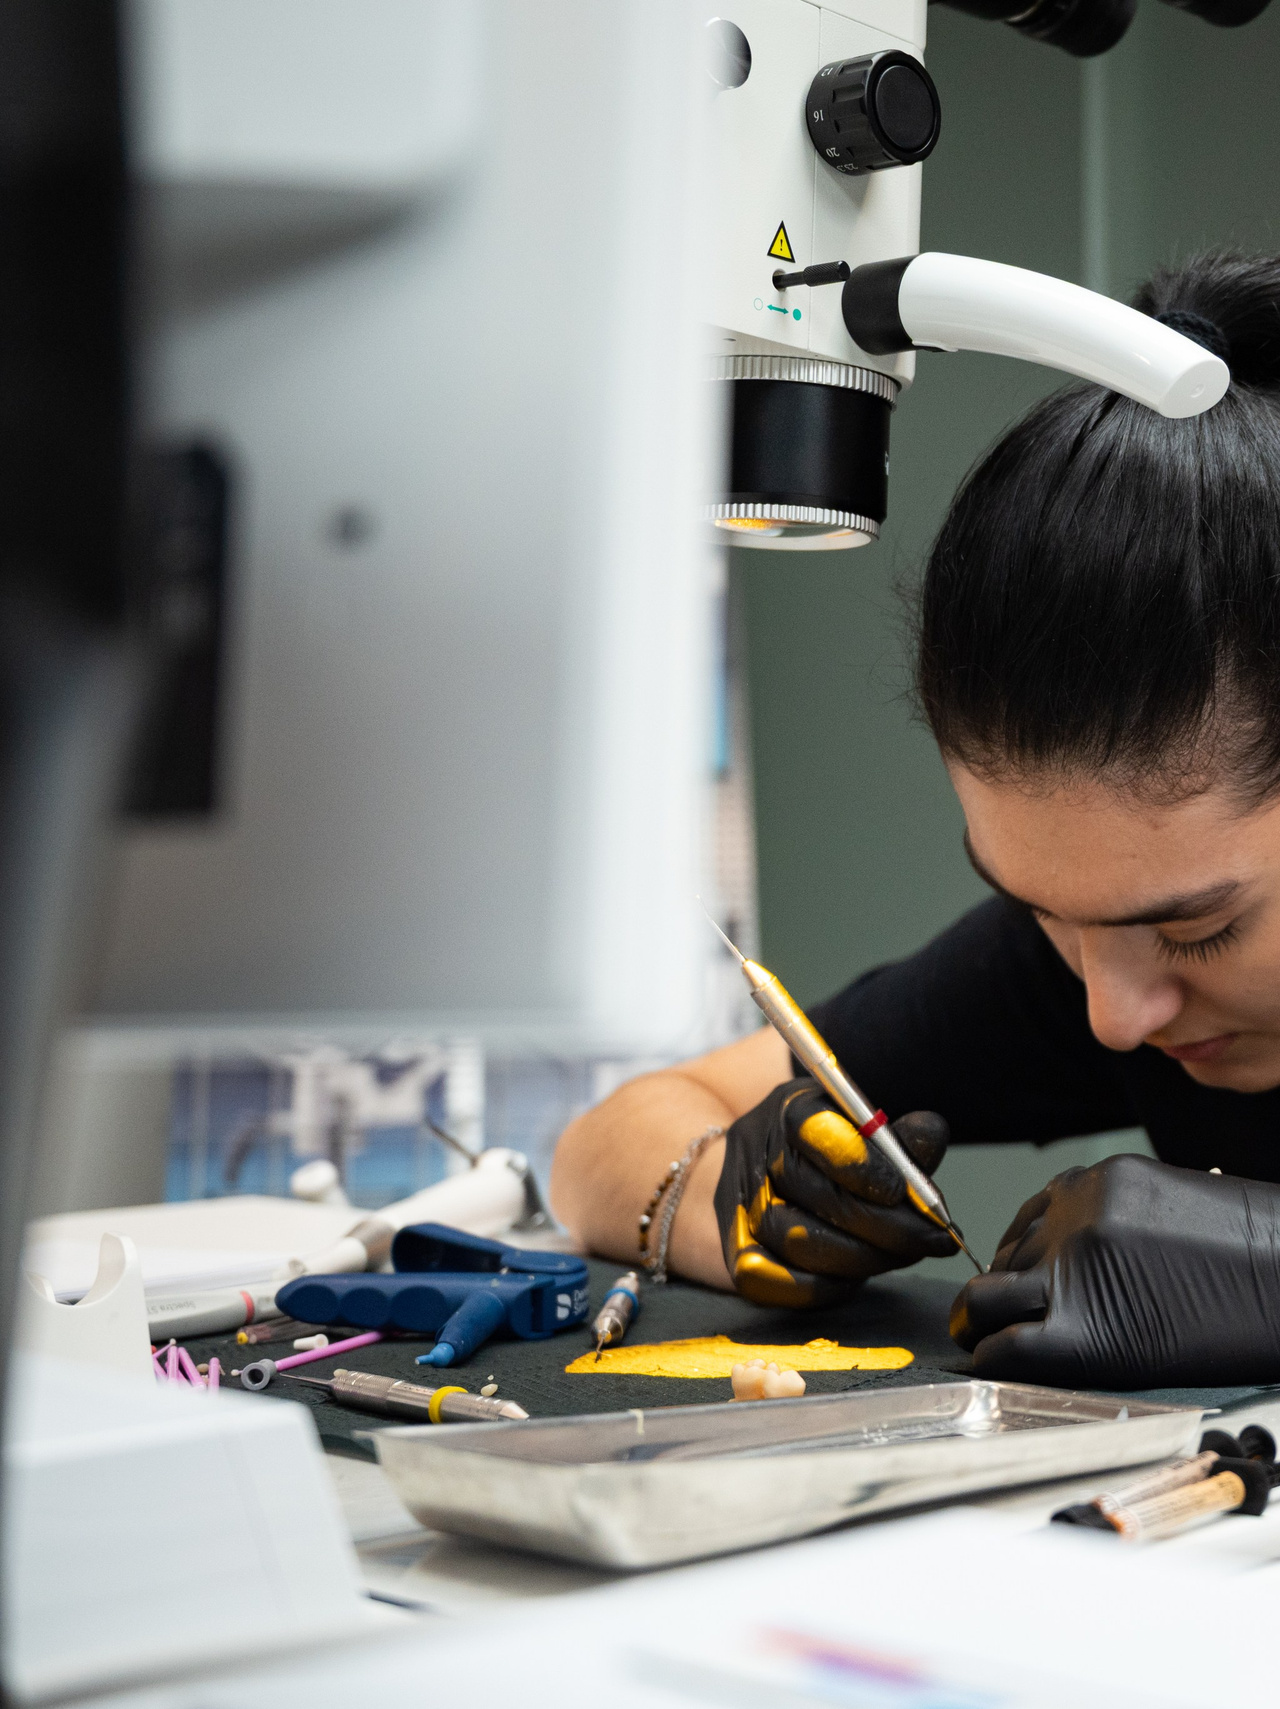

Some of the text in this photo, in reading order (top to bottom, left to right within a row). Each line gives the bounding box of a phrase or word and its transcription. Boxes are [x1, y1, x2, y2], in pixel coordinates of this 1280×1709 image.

[821, 67, 833, 77] 12
[813, 109, 824, 123] 16
[826, 148, 840, 158] 20
[159, 1300, 197, 1313] Spectra
